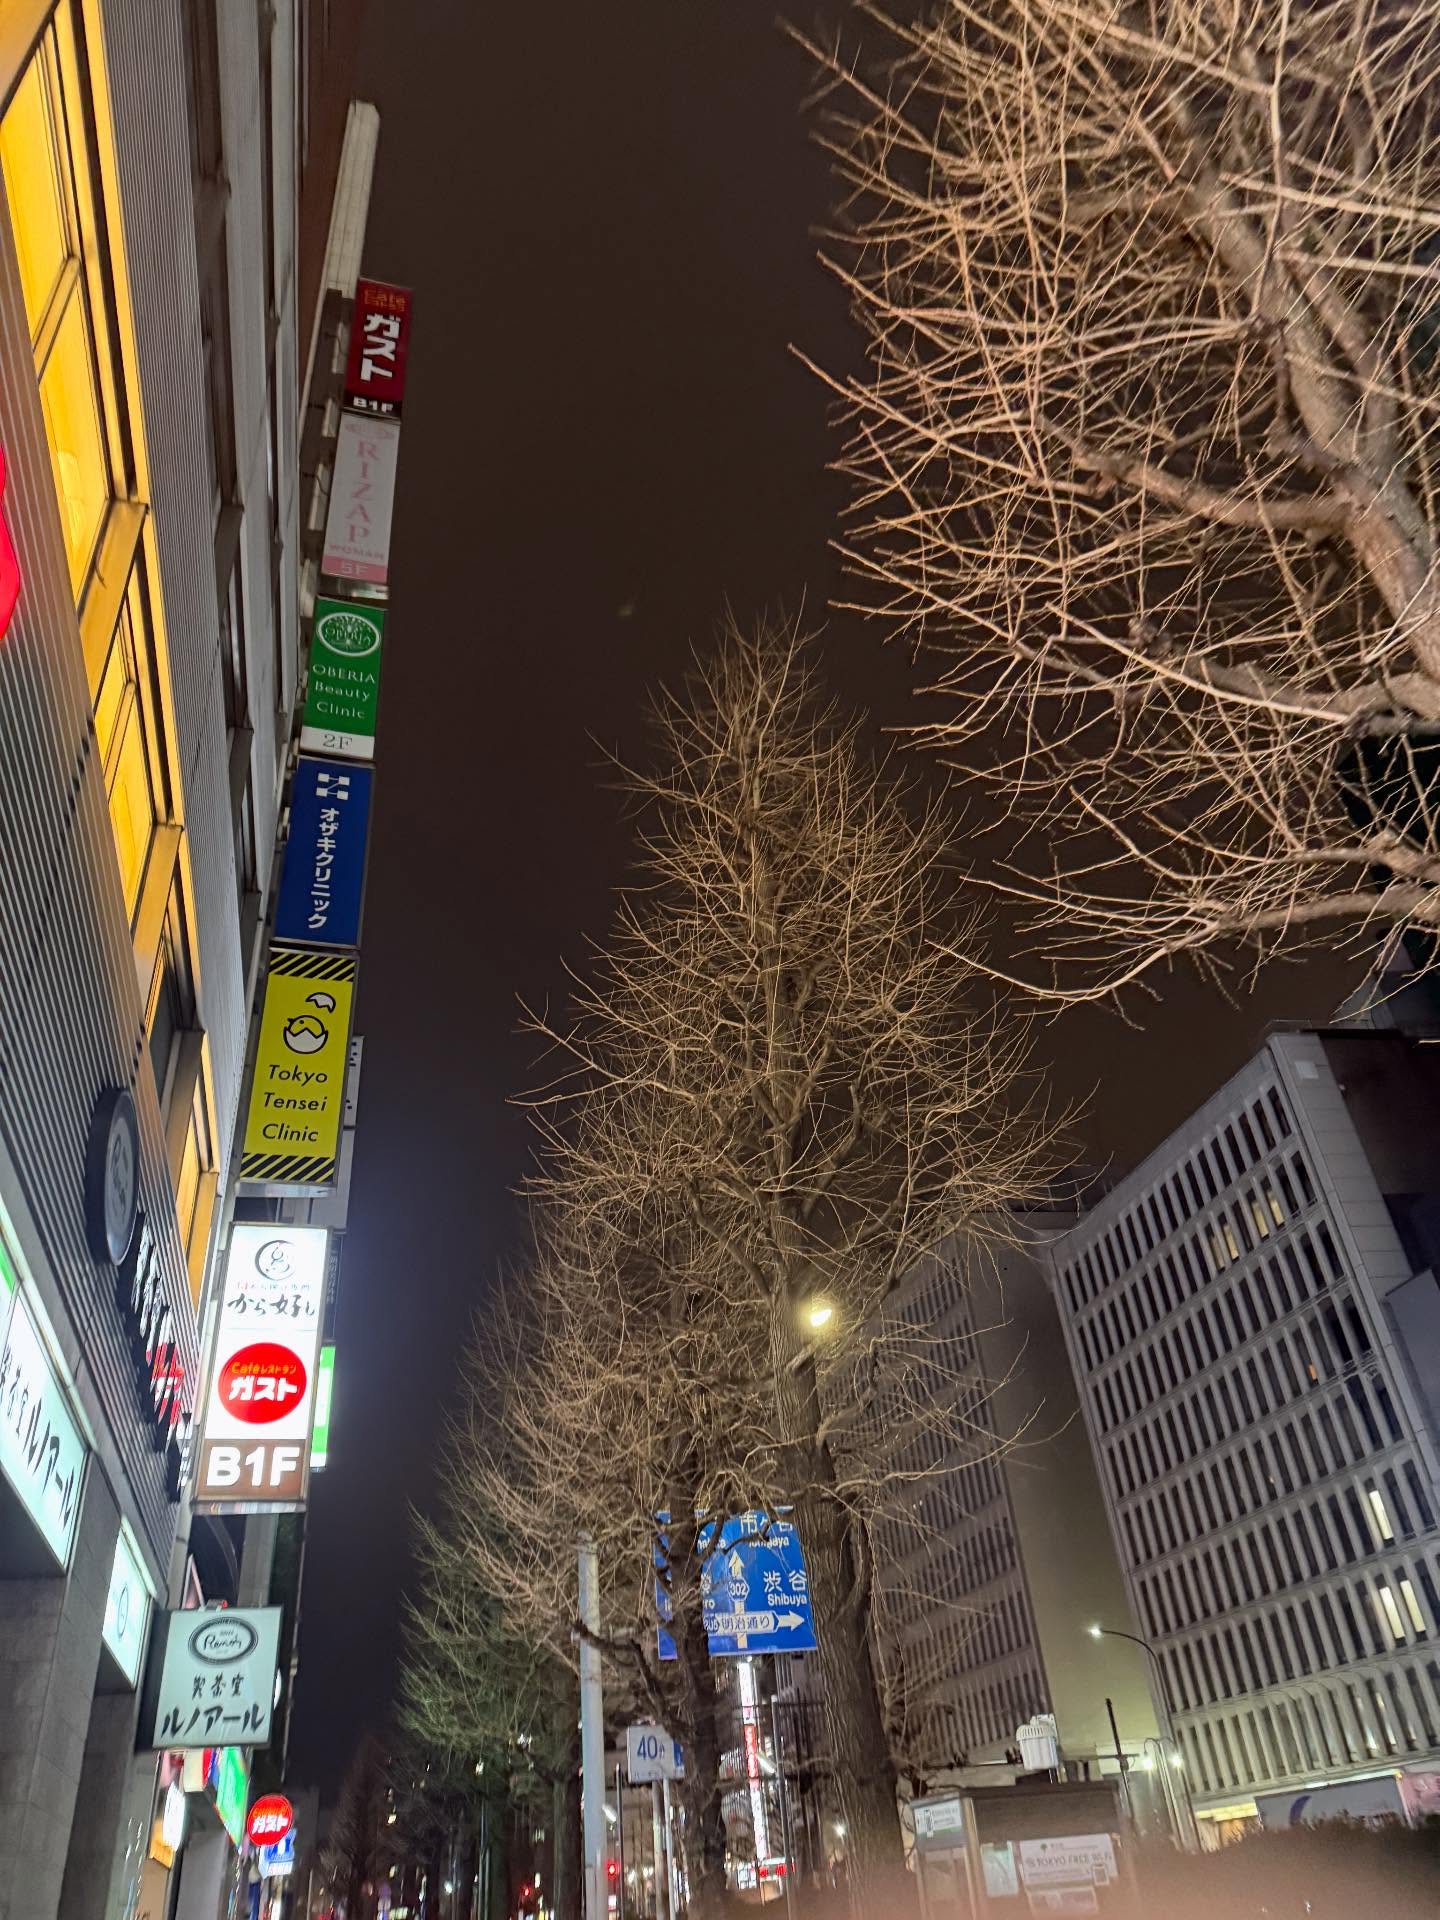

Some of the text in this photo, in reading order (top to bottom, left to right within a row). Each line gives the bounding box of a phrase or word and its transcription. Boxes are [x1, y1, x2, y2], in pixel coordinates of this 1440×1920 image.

[360, 312, 401, 382] ガスト
[353, 396, 393, 413] B1F
[347, 440, 379, 543] RIZAP
[312, 664, 376, 684] OBERIA
[315, 680, 370, 702] Beauty
[316, 701, 366, 719] Clinic
[323, 733, 353, 750] 2F
[307, 807, 340, 930] オザキクリニック
[268, 1064, 328, 1086] Tokyo
[263, 1092, 328, 1112] Tensei
[262, 1123, 319, 1143] Clinic
[228, 1376, 298, 1401] ガスト
[206, 1446, 300, 1488] B1F
[729, 1582, 747, 1596] 302
[763, 1569, 808, 1593] 渋谷
[767, 1592, 808, 1608] Shibuya
[161, 1703, 265, 1738] ルノアール
